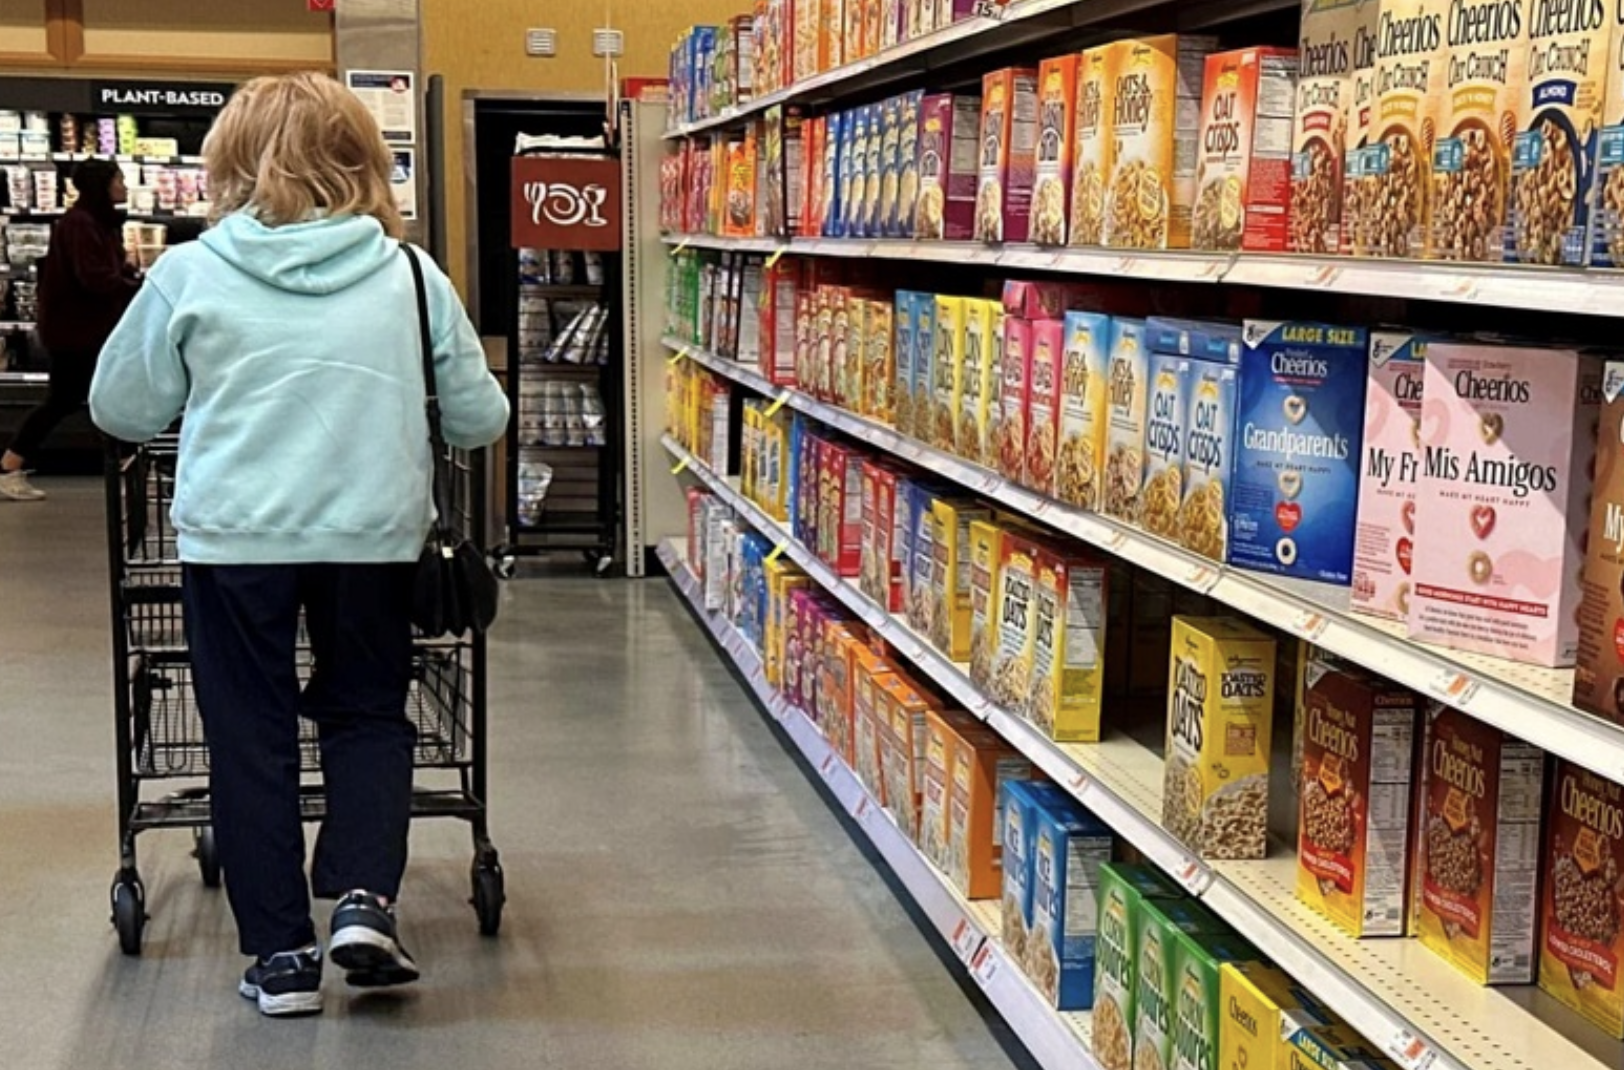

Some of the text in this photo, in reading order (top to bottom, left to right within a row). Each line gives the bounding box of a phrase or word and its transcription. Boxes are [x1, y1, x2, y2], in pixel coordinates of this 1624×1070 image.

[1378, 5, 1441, 57] Cheerios
[1448, 0, 1522, 46] Cheerios
[1529, 0, 1604, 39] Cheerios
[1300, 32, 1349, 77] Cheerios
[101, 88, 224, 106] PLANT-BASED
[1213, 92, 1236, 121] OAT
[1282, 326, 1322, 343] LARGE
[1327, 329, 1355, 344] SIZE
[1271, 352, 1327, 377] Cheerios
[1155, 391, 1176, 421] OAT
[1455, 370, 1530, 403] Cheerios
[1196, 399, 1217, 432] OAT
[1244, 422, 1348, 461] Grandparents
[1367, 447, 1394, 487] My
[1423, 445, 1557, 497] Mis Amigos
[1221, 682, 1265, 698] OATS
[1172, 689, 1205, 752] OATS
[1309, 708, 1359, 762] Cheerios
[1433, 740, 1485, 798] Cheerios
[1561, 774, 1623, 840] Cheerios
